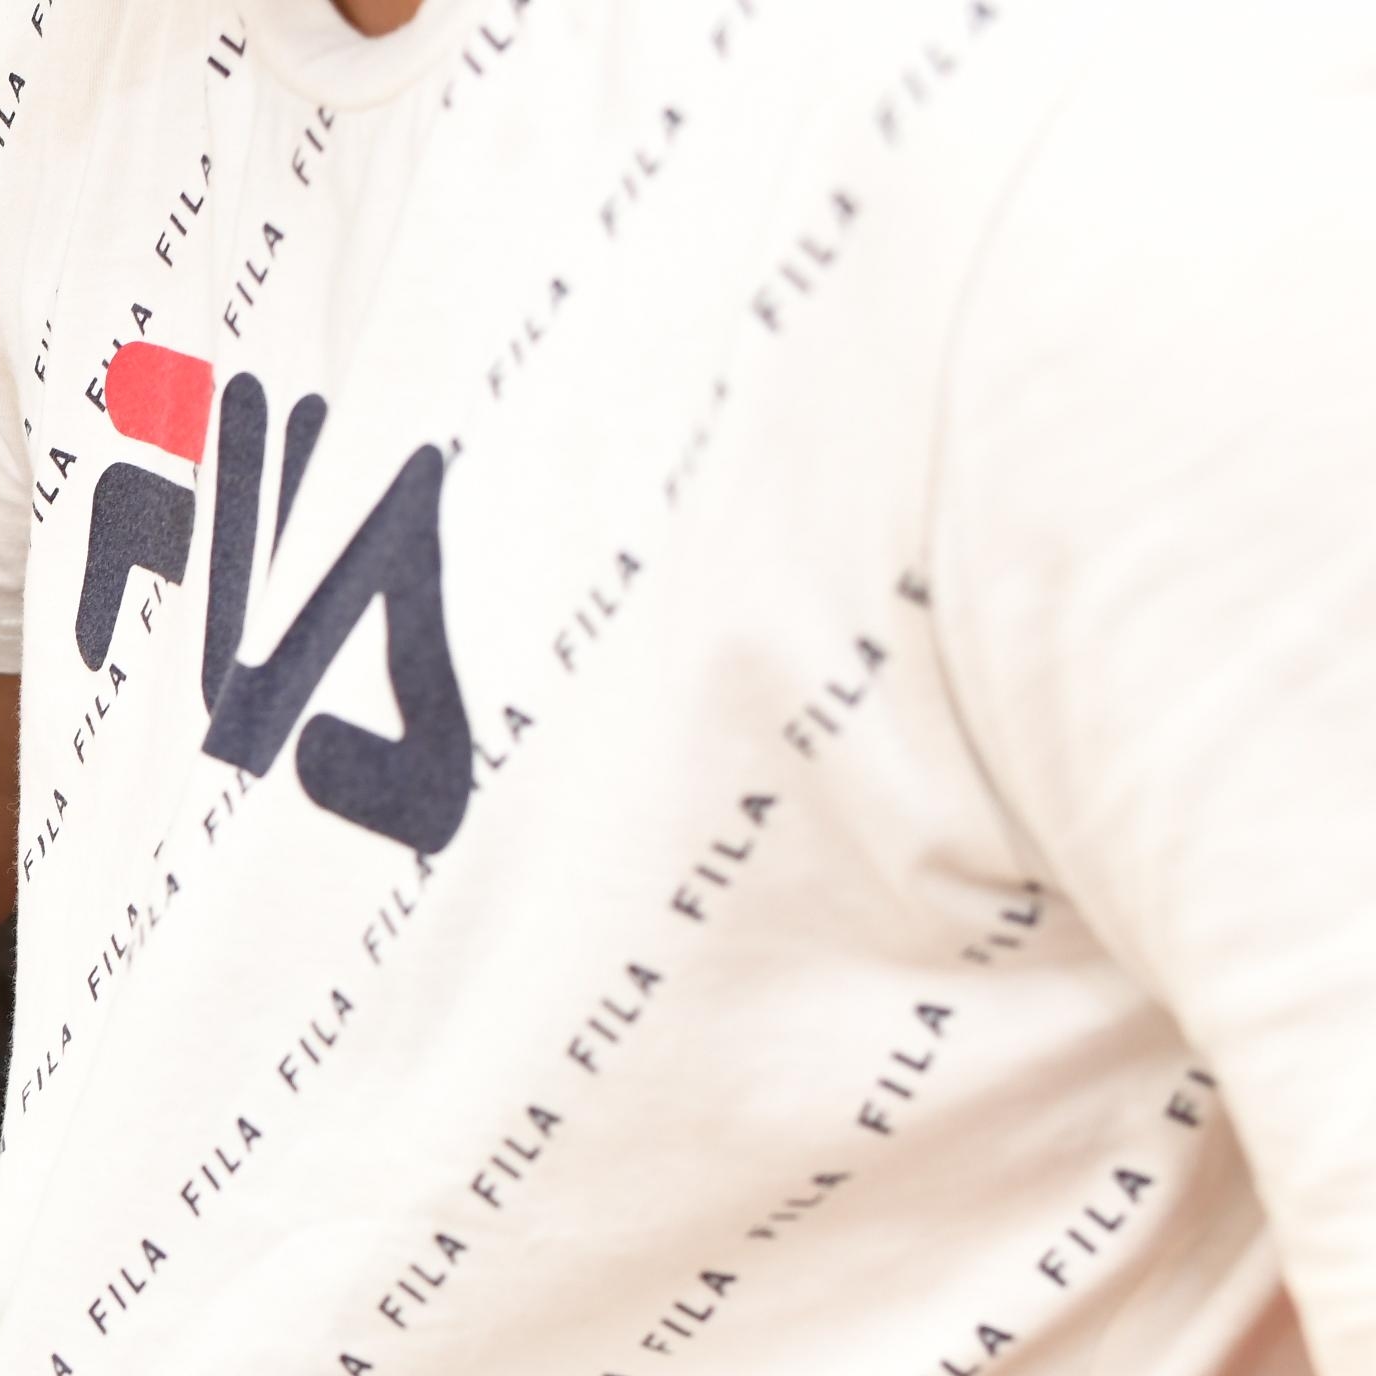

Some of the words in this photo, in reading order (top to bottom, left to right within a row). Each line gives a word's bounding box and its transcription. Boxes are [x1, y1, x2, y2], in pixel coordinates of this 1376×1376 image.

[32, 447, 77, 522] ILA
[155, 153, 212, 268] FILA
[207, 19, 247, 79] IL
[223, 221, 285, 339] FILA
[488, 278, 569, 397] FILA
[601, 107, 684, 234] FILA
[24, 789, 68, 882] FILA
[73, 663, 127, 765] FILA
[87, 1238, 168, 1336] FILA
[180, 1116, 263, 1218] FILA
[277, 989, 354, 1093] FILA
[554, 551, 642, 672] FILA
[753, 191, 858, 332] FILA
[22, 1023, 72, 1113] FILA
[87, 903, 138, 1001] FILA
[377, 1232, 468, 1330] FILA
[469, 1104, 563, 1209] FILA
[566, 962, 664, 1075] FILA
[669, 793, 779, 923] FILA
[784, 635, 888, 758] FILA
[640, 1269, 738, 1354] FILA
[856, 1002, 954, 1137] FILA
[1036, 1168, 1154, 1288] FILA
